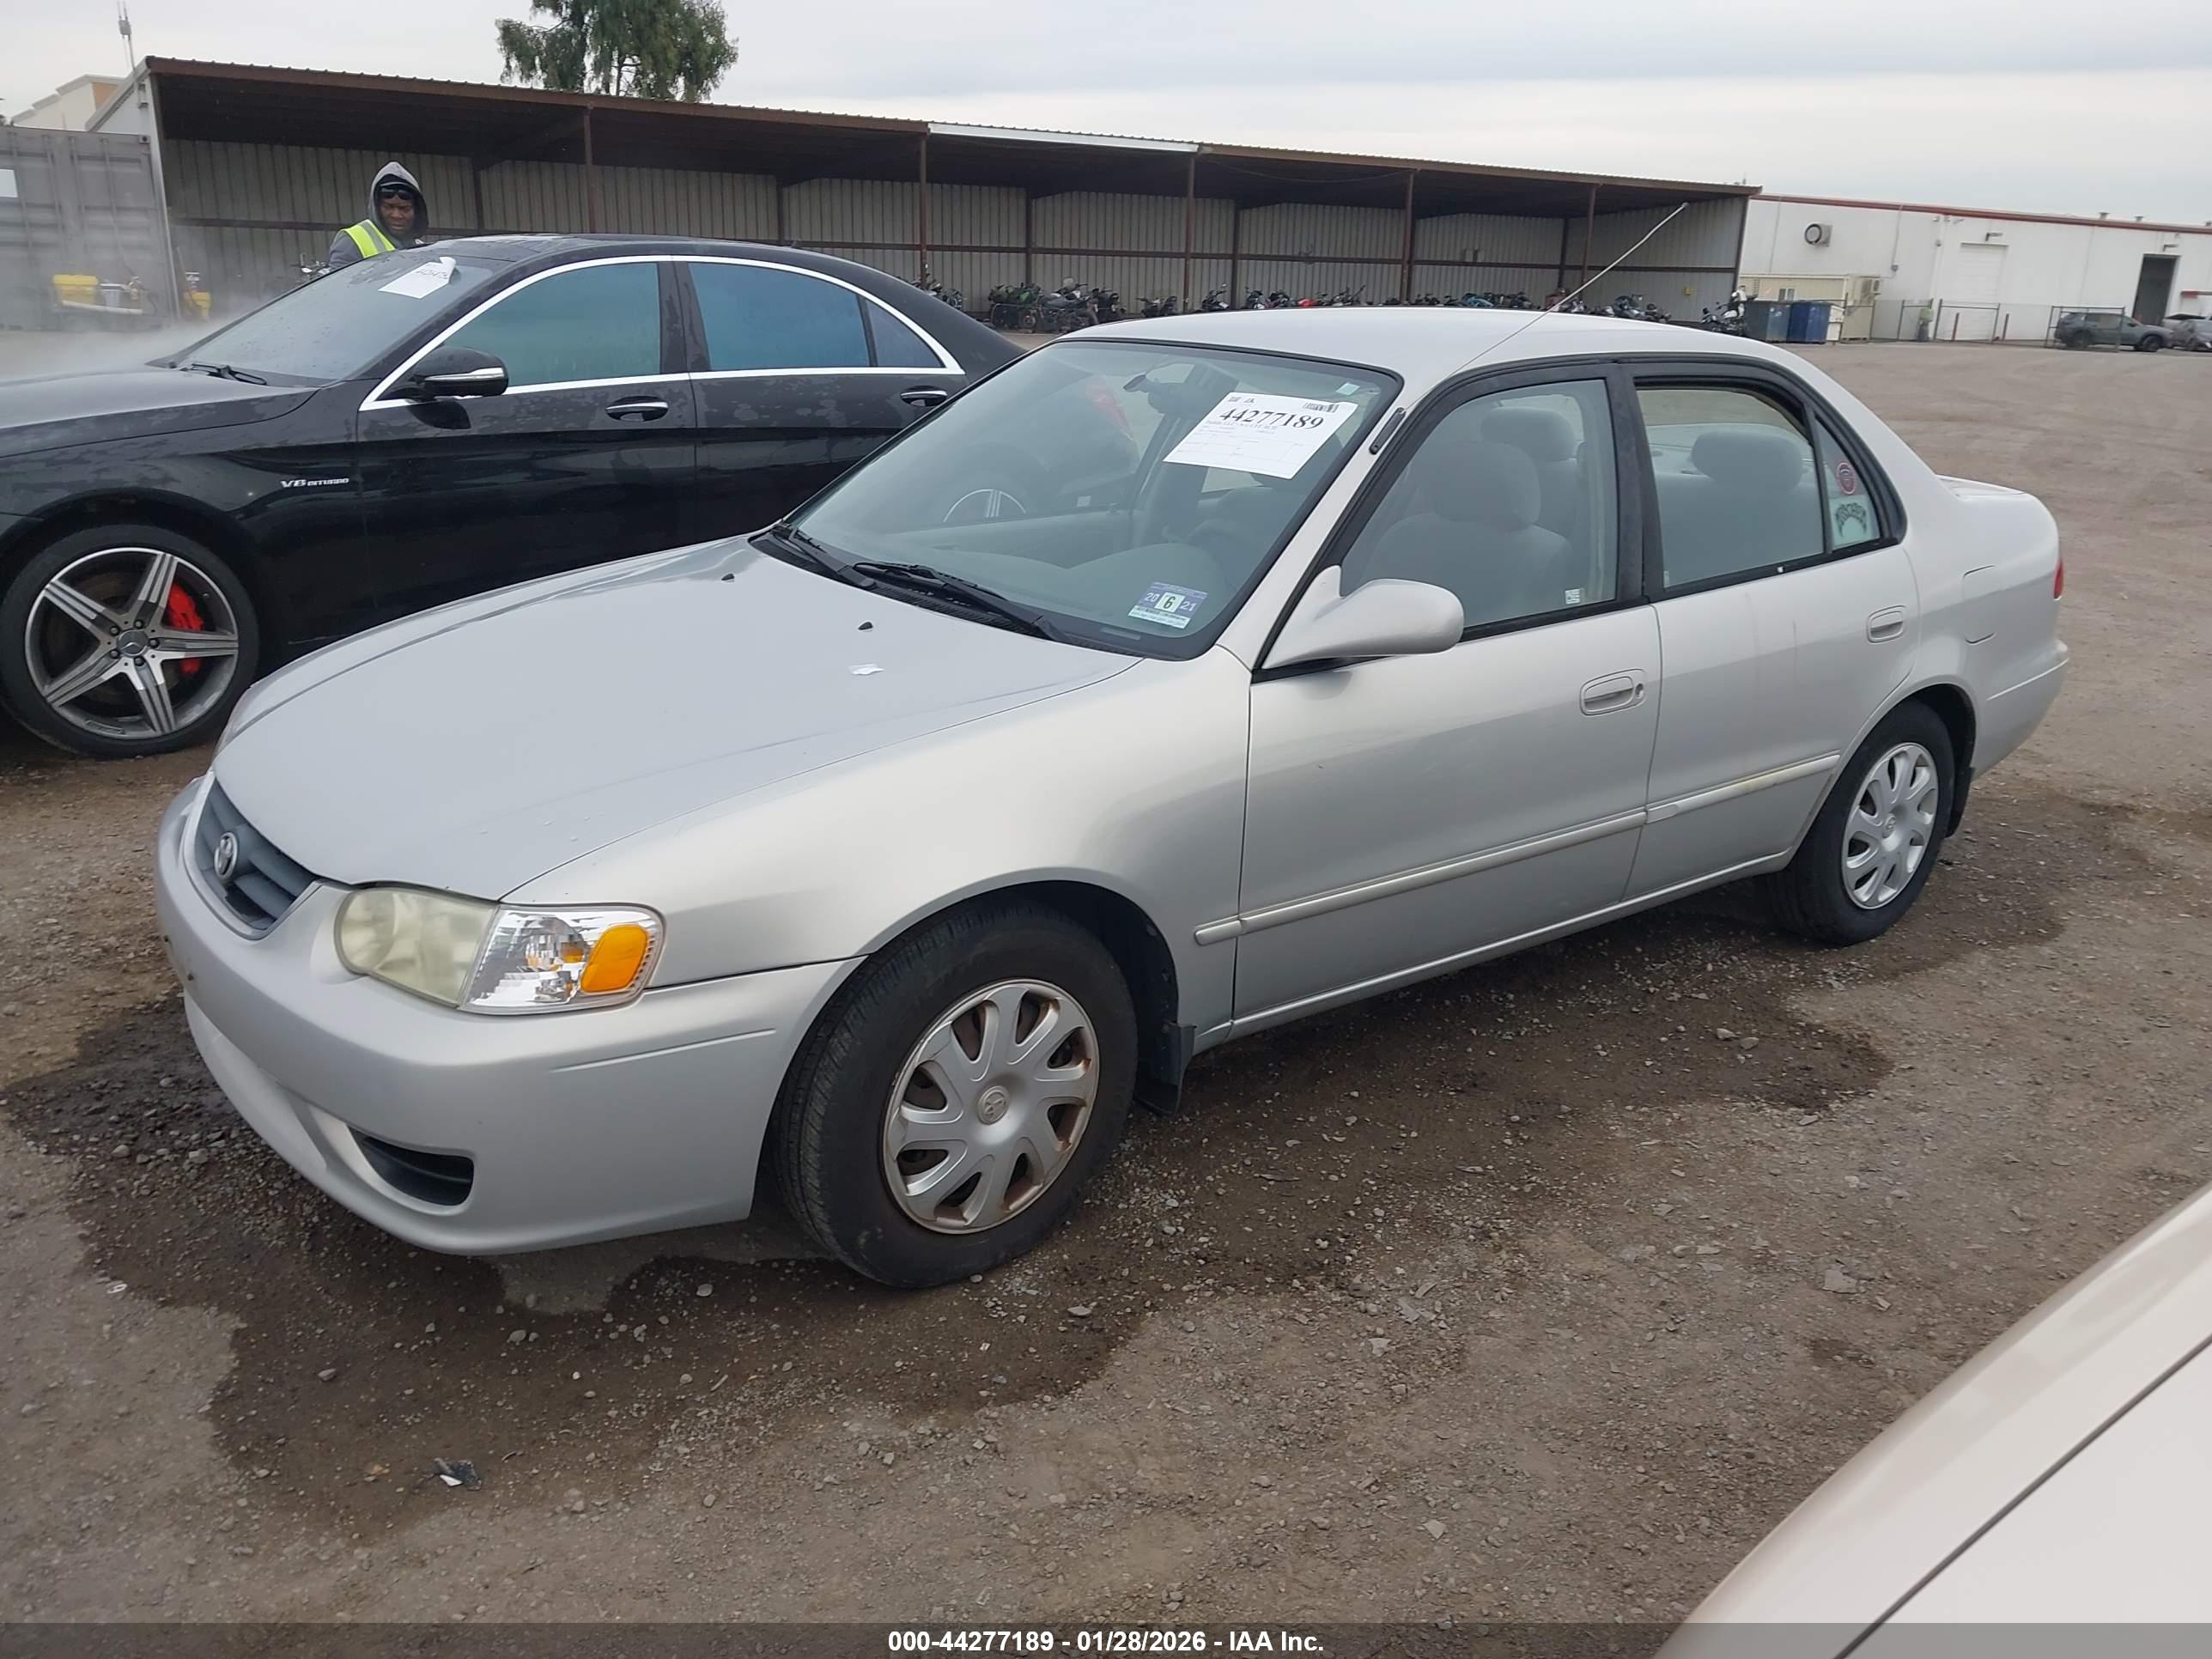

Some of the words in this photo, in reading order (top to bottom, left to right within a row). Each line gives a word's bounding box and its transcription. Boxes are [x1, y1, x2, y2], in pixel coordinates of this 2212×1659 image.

[1219, 408, 1324, 430] 44277189
[280, 479, 307, 488] V8
[1145, 592, 1160, 602] 20
[1163, 596, 1176, 610] 6
[1180, 601, 1197, 611] 21
